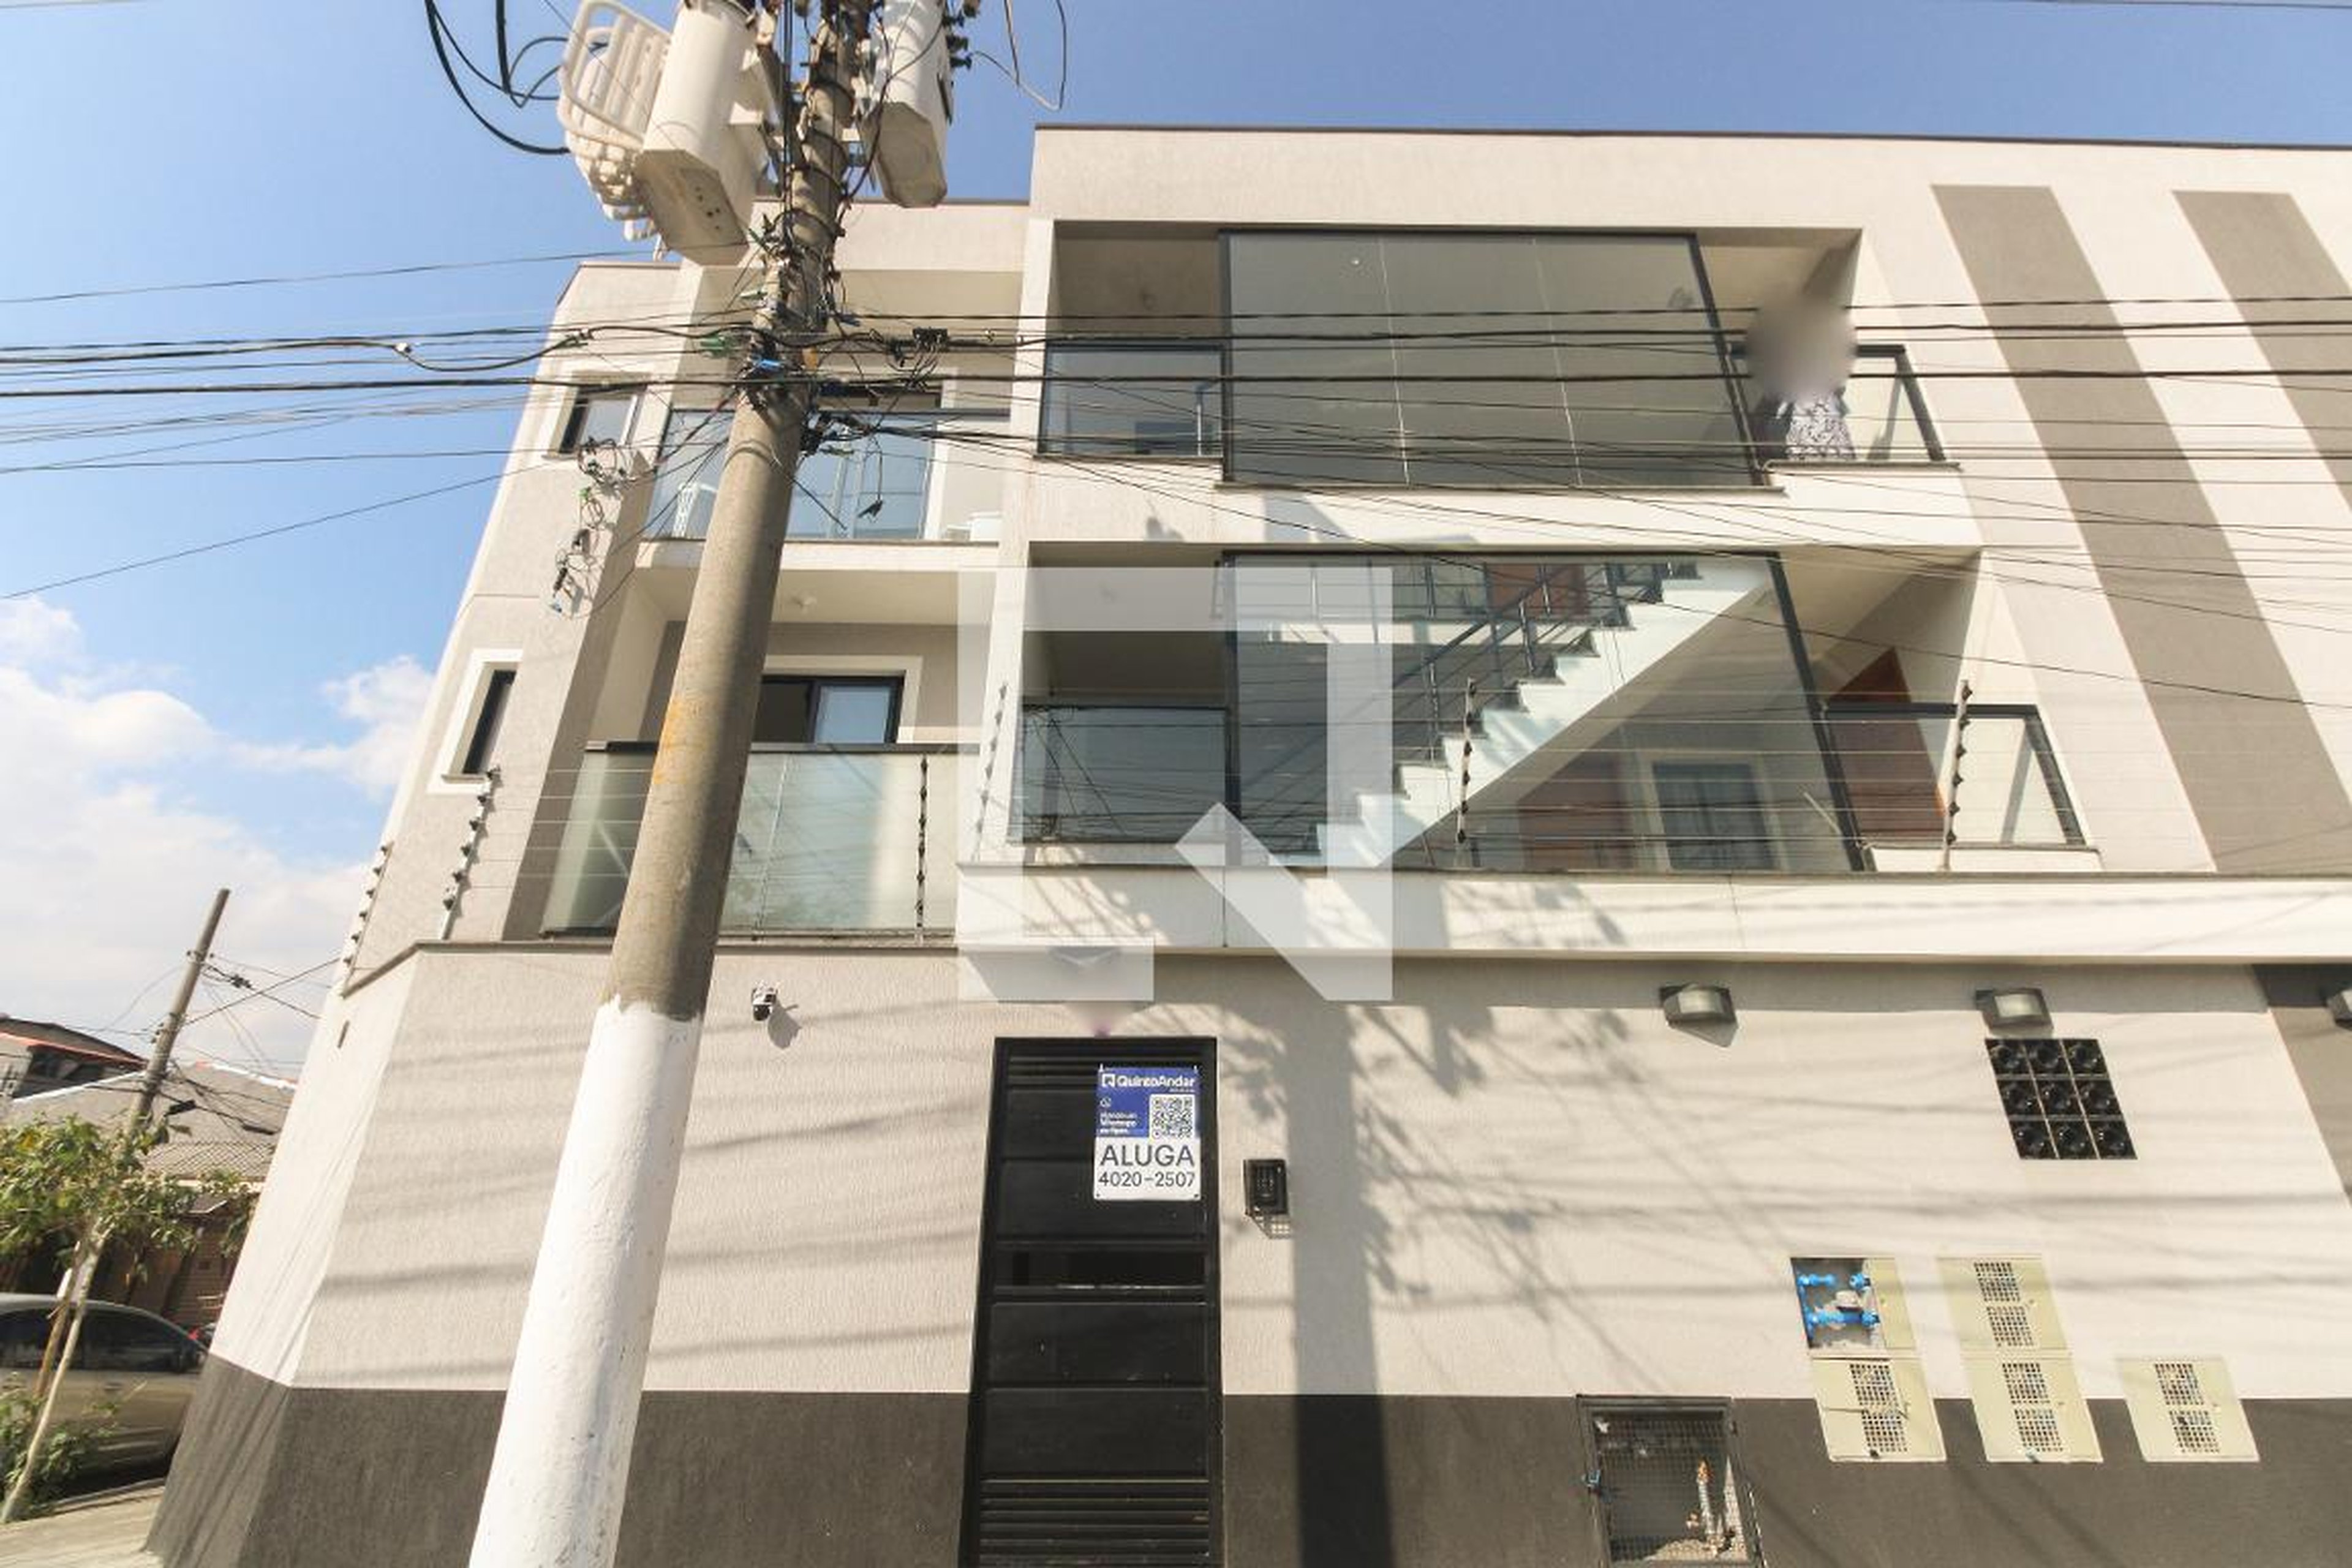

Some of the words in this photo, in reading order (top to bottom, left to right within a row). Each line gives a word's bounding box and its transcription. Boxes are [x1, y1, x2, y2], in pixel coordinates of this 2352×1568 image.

[1117, 1075, 1196, 1087] QuintoAndar
[1100, 1145, 1195, 1166] ALUGA
[1098, 1171, 1196, 1187] 4020-2507
